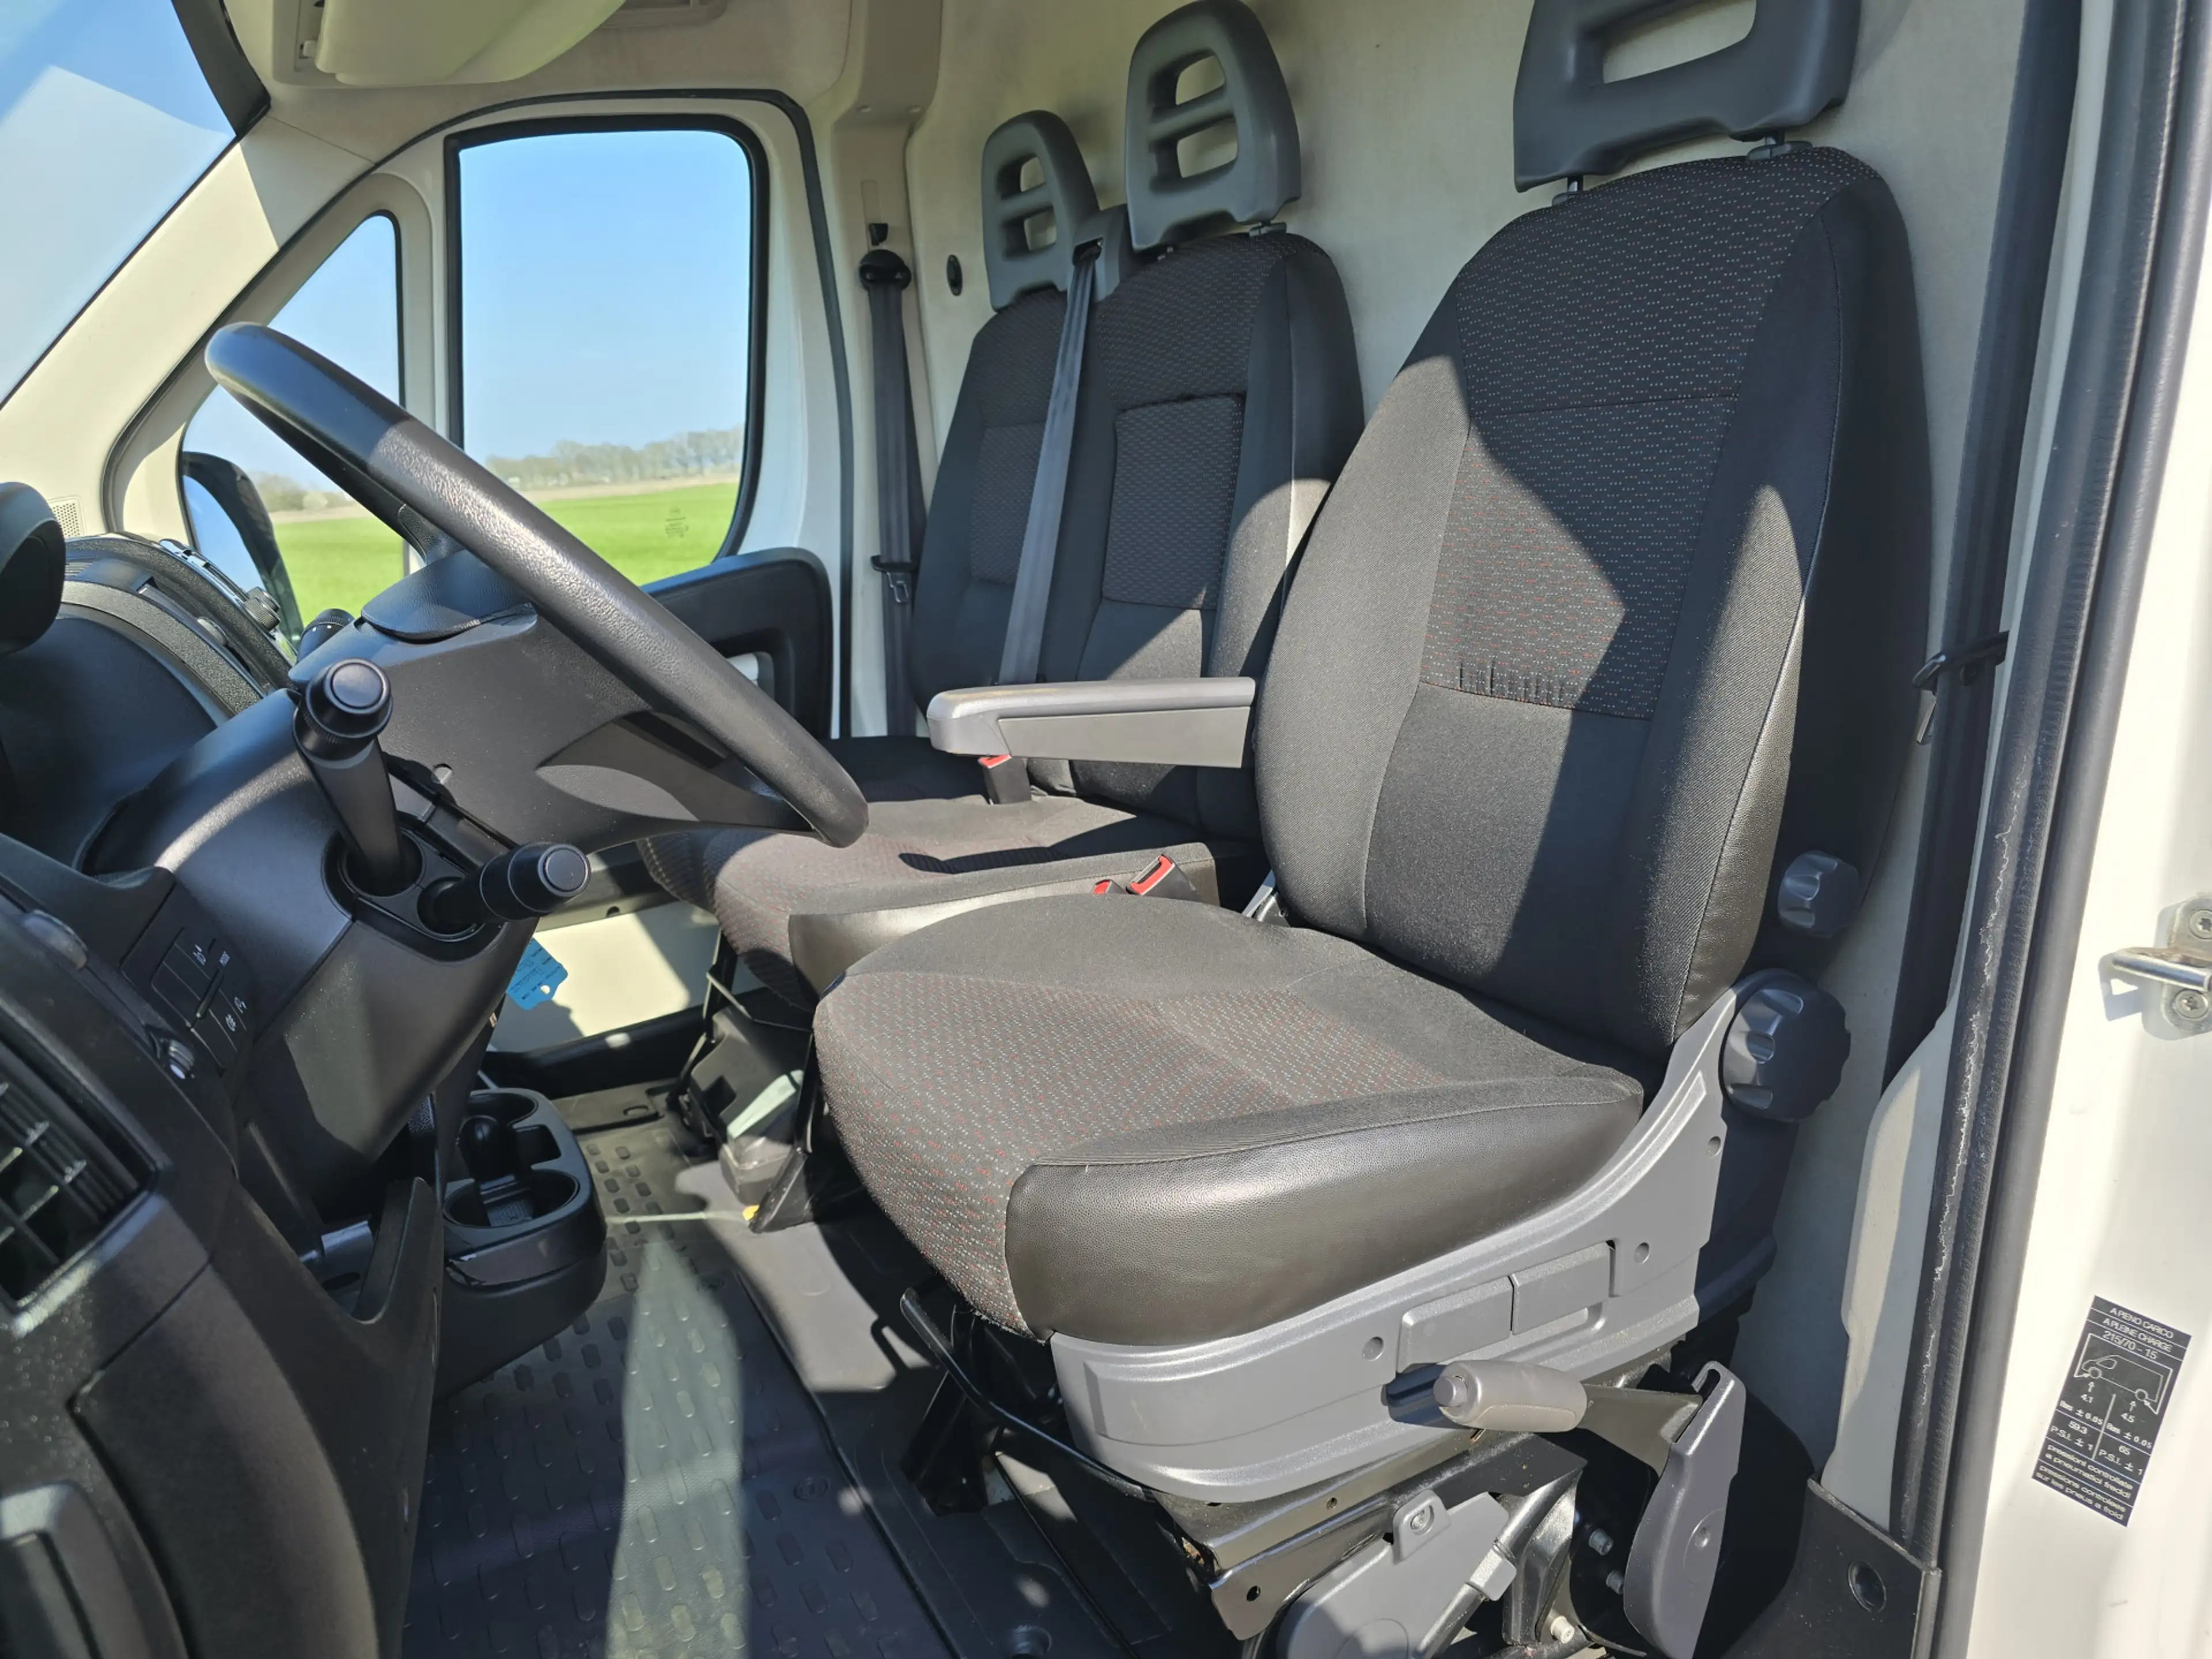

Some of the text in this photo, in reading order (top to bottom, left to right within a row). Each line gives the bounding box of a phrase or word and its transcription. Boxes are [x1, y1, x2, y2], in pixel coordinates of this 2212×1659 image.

[2111, 1320, 2138, 1337] PLEINE
[2138, 1333, 2173, 1353] CHARGE
[2118, 1310, 2142, 1325] PIENO
[2143, 1321, 2173, 1338] CARICO
[2103, 1330, 2136, 1350] 215/70
[2145, 1349, 2157, 1359] 15
